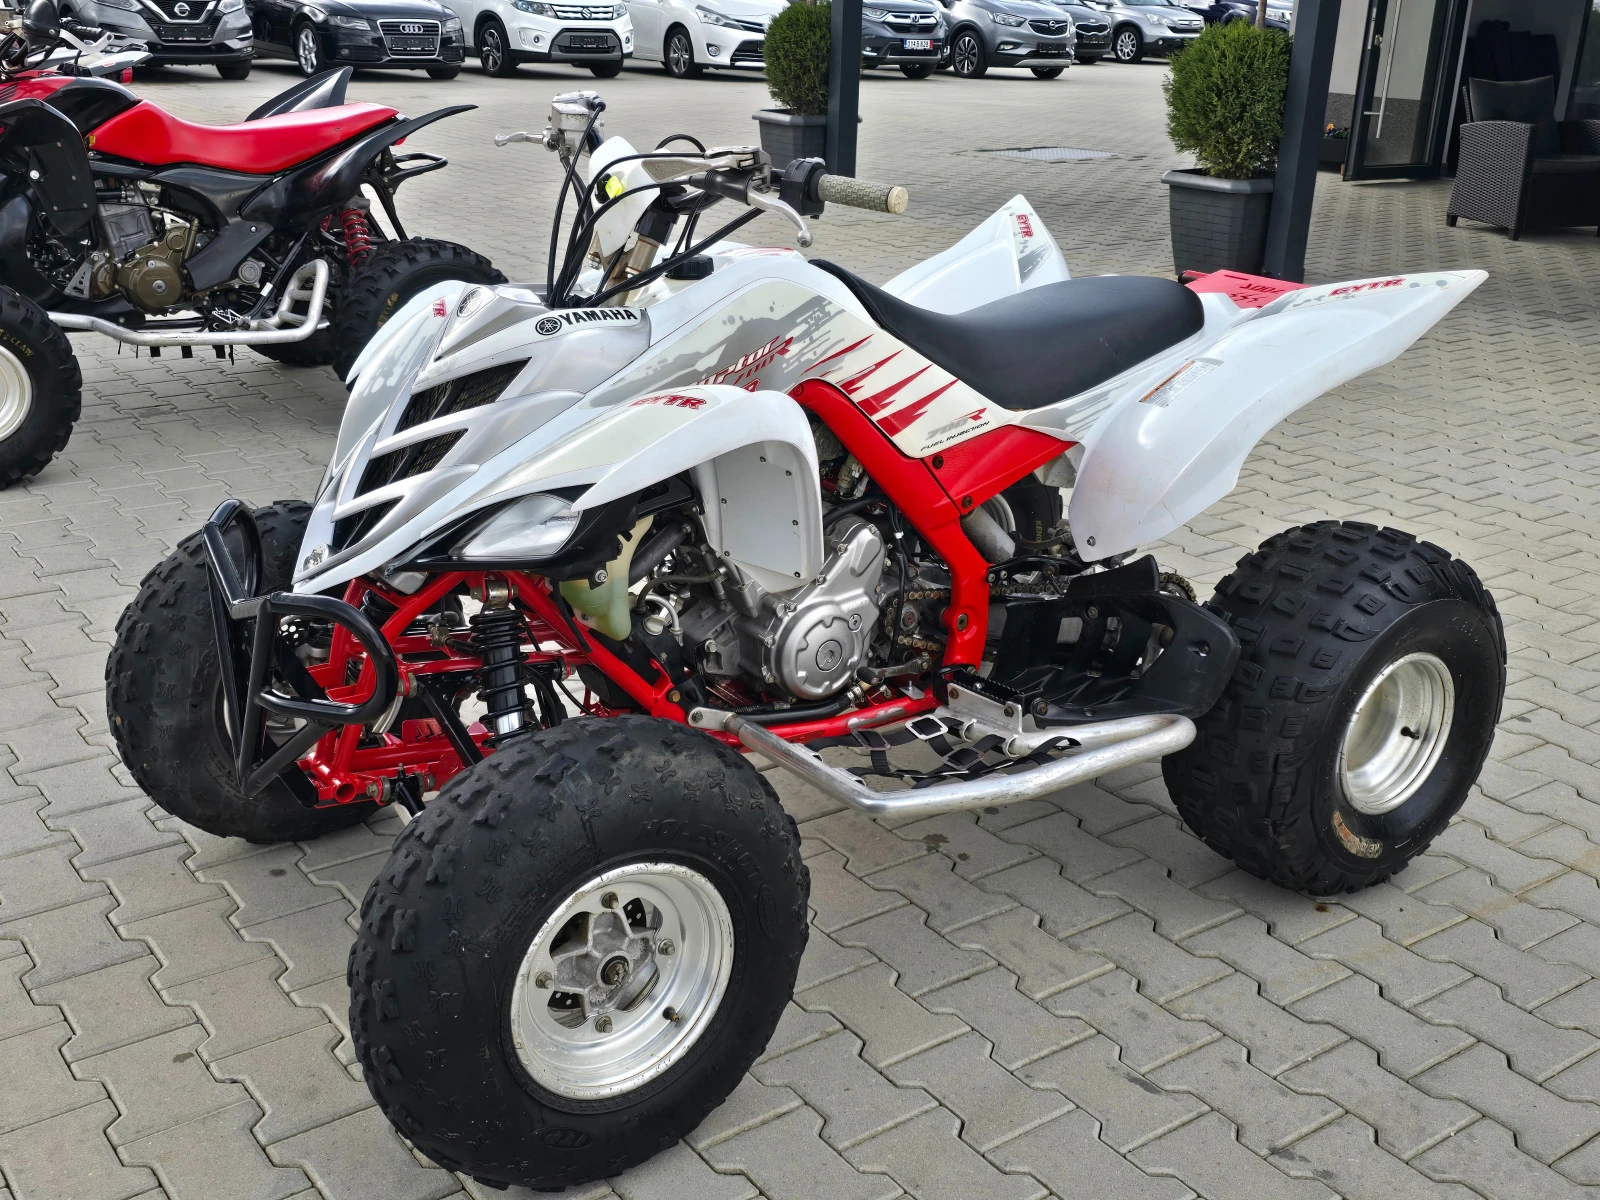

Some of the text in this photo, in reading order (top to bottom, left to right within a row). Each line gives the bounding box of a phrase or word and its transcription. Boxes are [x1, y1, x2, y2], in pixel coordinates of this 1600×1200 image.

[1016, 214, 1034, 238] GYTR
[1328, 278, 1405, 296] GYTR
[558, 309, 638, 325] YAMAHA
[921, 421, 990, 451] FUEL INJECTION
[1035, 520, 1043, 543] KEND
